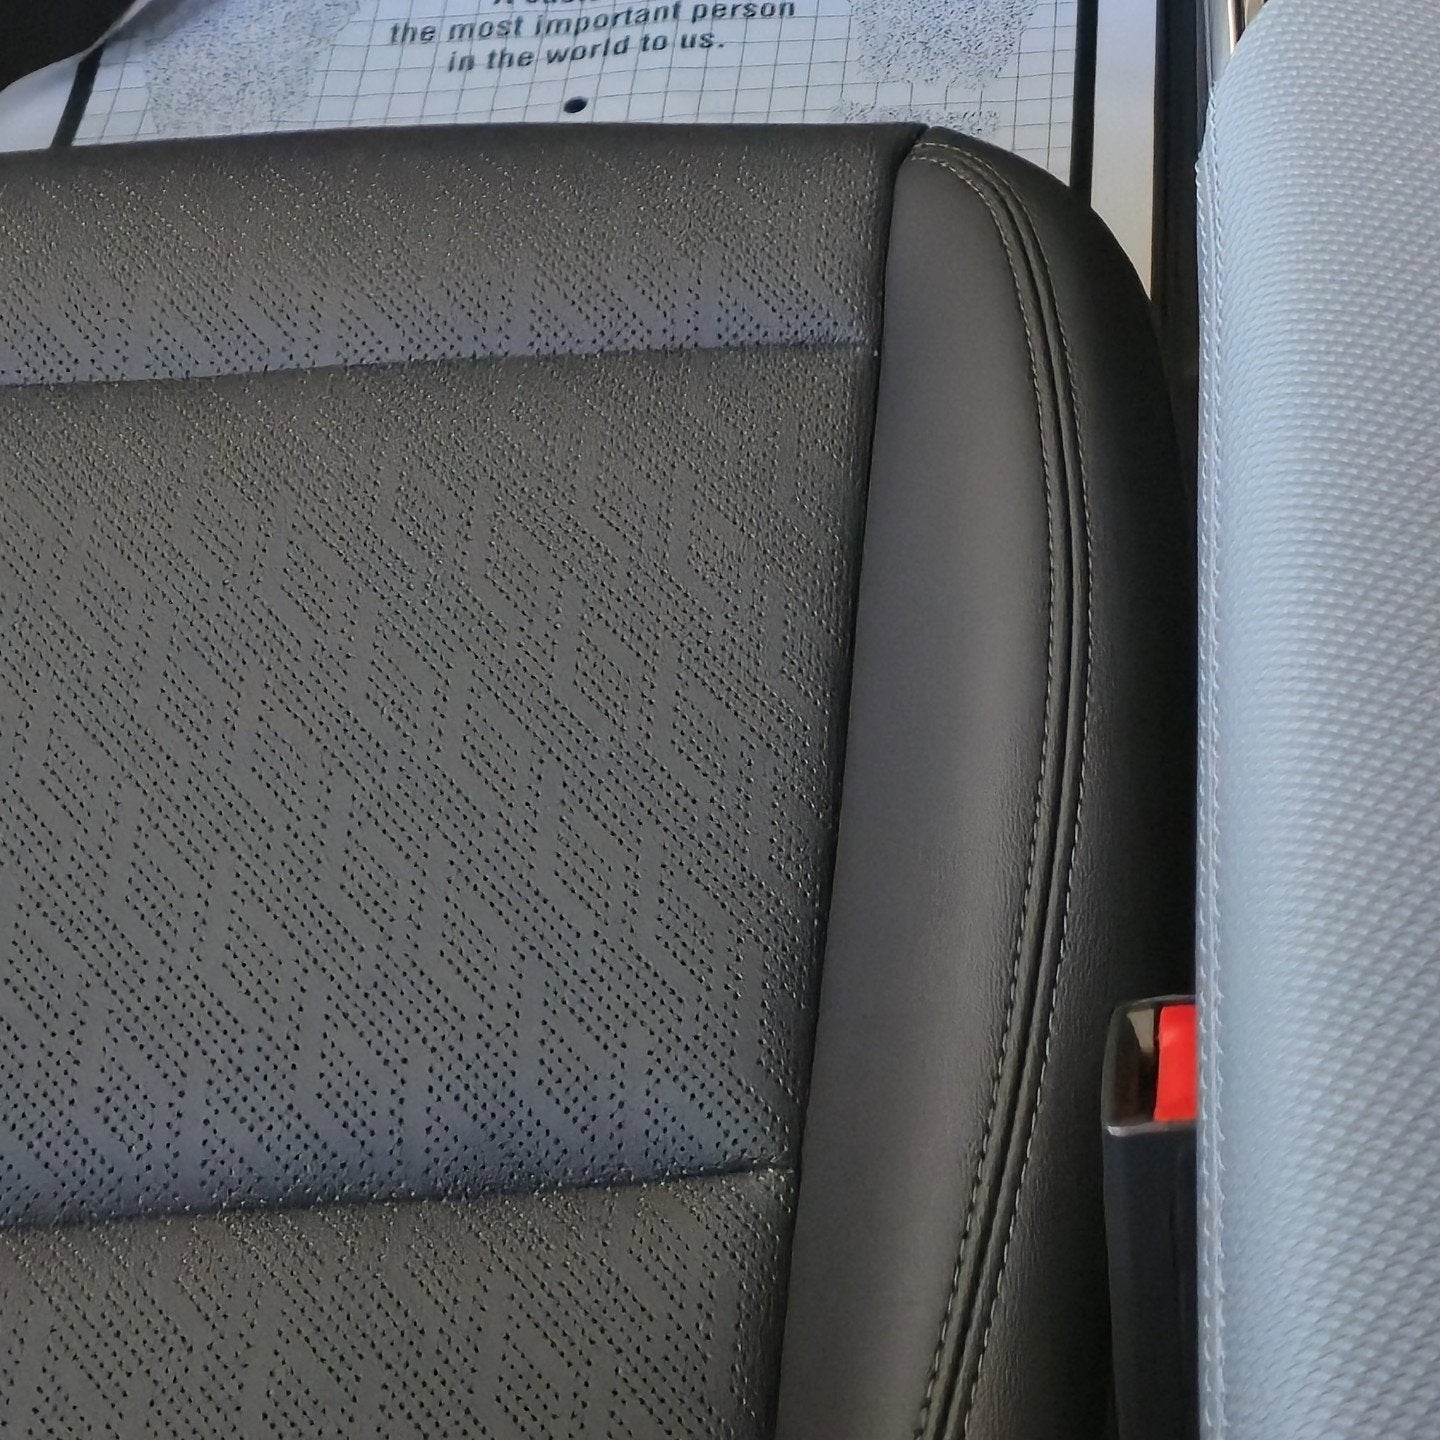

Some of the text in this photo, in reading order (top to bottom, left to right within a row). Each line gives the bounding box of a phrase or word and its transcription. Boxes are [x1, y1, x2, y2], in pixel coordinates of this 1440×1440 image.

[390, 0, 795, 44] the most important person
[447, 31, 724, 72] in the world to us.
